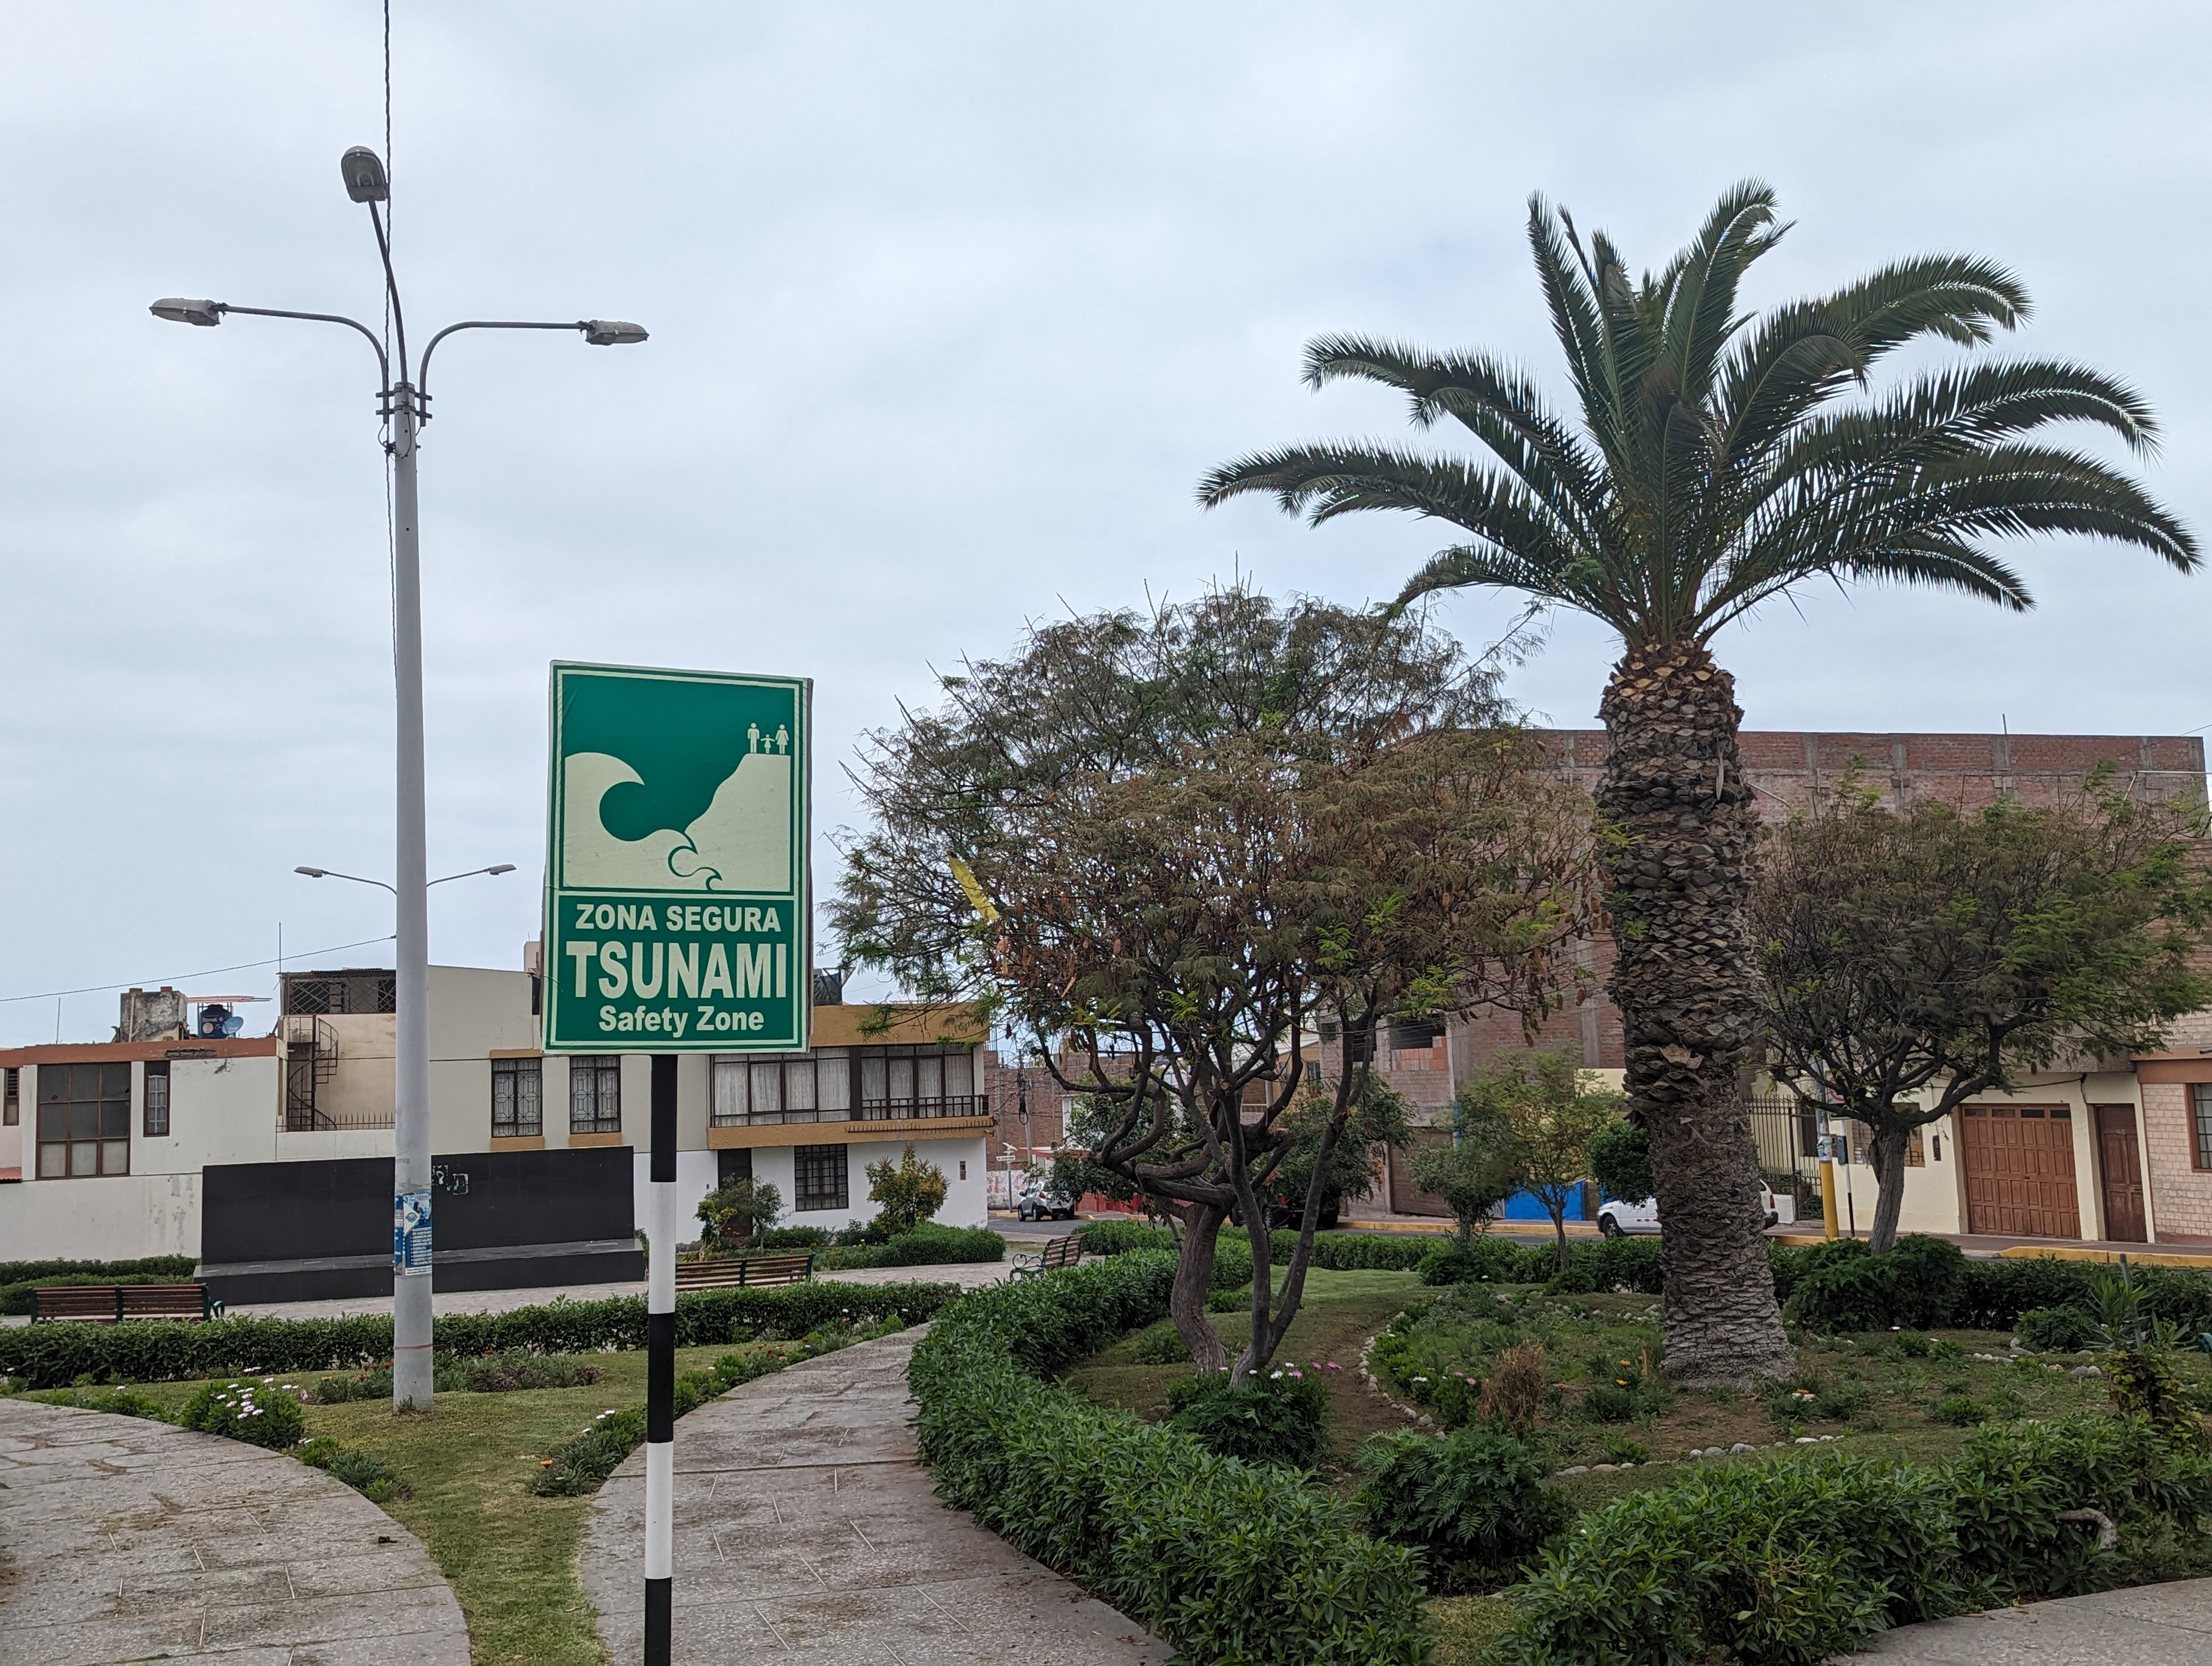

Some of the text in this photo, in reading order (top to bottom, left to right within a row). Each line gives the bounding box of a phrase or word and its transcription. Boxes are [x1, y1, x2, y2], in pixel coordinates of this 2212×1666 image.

[575, 904, 781, 932] ZONA SEGURA
[566, 941, 787, 999] TSUNAMI
[599, 1005, 764, 1038] Safety Zone
